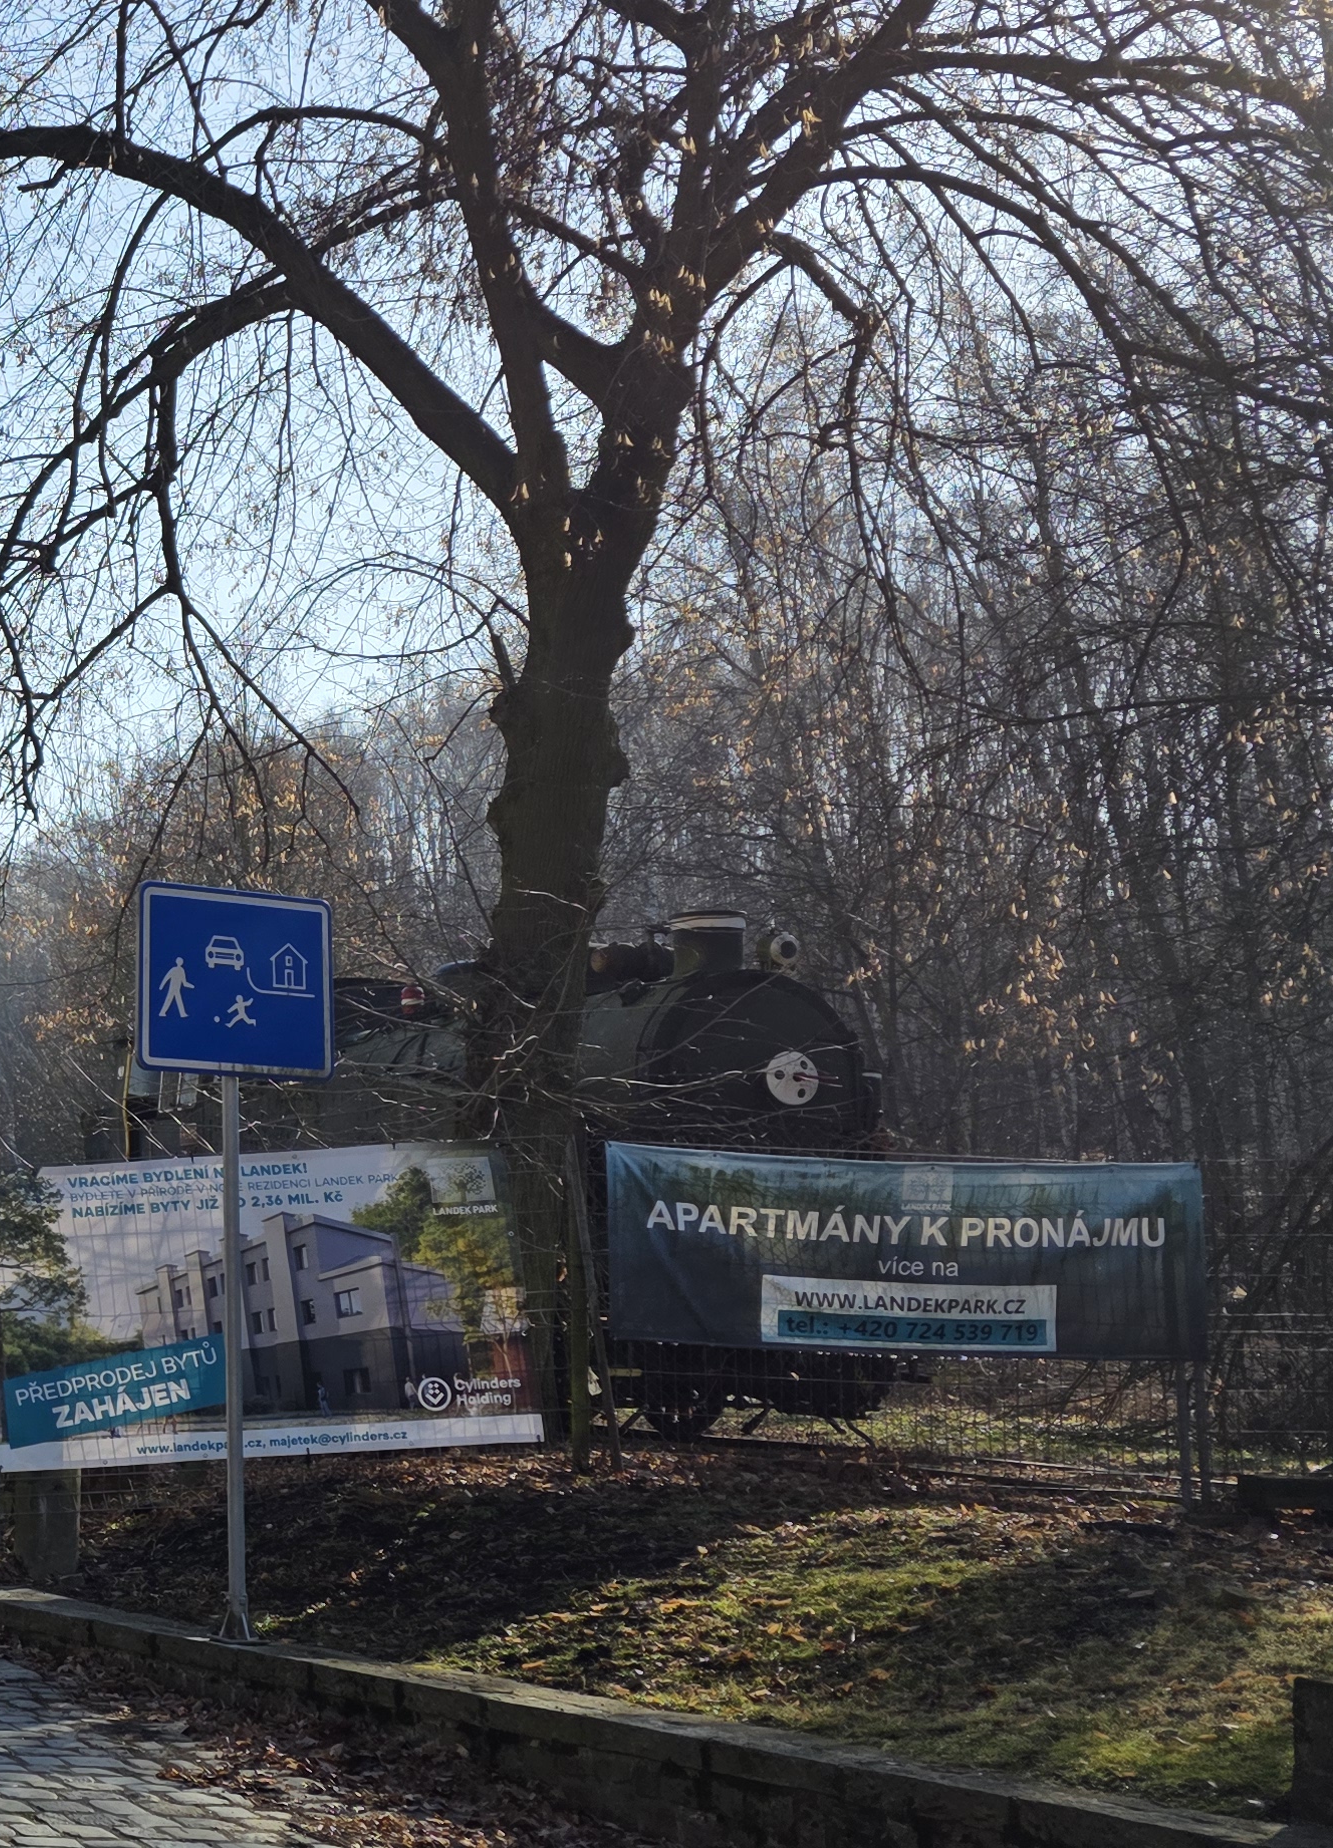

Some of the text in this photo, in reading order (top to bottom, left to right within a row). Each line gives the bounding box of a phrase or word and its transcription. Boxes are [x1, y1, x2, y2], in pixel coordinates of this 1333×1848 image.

[67, 1172, 139, 1188] VRACÍME
[143, 1165, 209, 1183] BYDLENÍ
[241, 1163, 308, 1177] LANDEK!
[70, 1190, 123, 1203] BYDLETE
[128, 1189, 136, 1198] V
[141, 1183, 193, 1197] PŘÍRODĚ
[196, 1184, 205, 1193] V
[247, 1180, 311, 1191] REZIDENCI
[315, 1176, 364, 1187] LANDEK
[368, 1173, 399, 1184] PARK
[72, 1201, 145, 1218] NABÍZÍME
[150, 1200, 190, 1213] BYTY
[196, 1195, 220, 1210] JIŽ
[251, 1195, 283, 1209] 2,36
[287, 1193, 320, 1205] MIL.
[432, 1204, 498, 1216] LANDEK PARK
[646, 1200, 1166, 1248] APARTMÁNY K PRONÁJMU
[878, 1256, 959, 1277] více na
[794, 1291, 1027, 1315] WWW.LANDEKPARK.CZ
[786, 1315, 1039, 1342] tel.: +420 724 539 719
[15, 1341, 218, 1406] PŘEDPRODEJ BYTŮ
[454, 1376, 521, 1393] Cylinders
[52, 1378, 191, 1429] ZAHÁJEN
[457, 1392, 512, 1406] Holding
[136, 1439, 266, 1455] www.landekp.cz,
